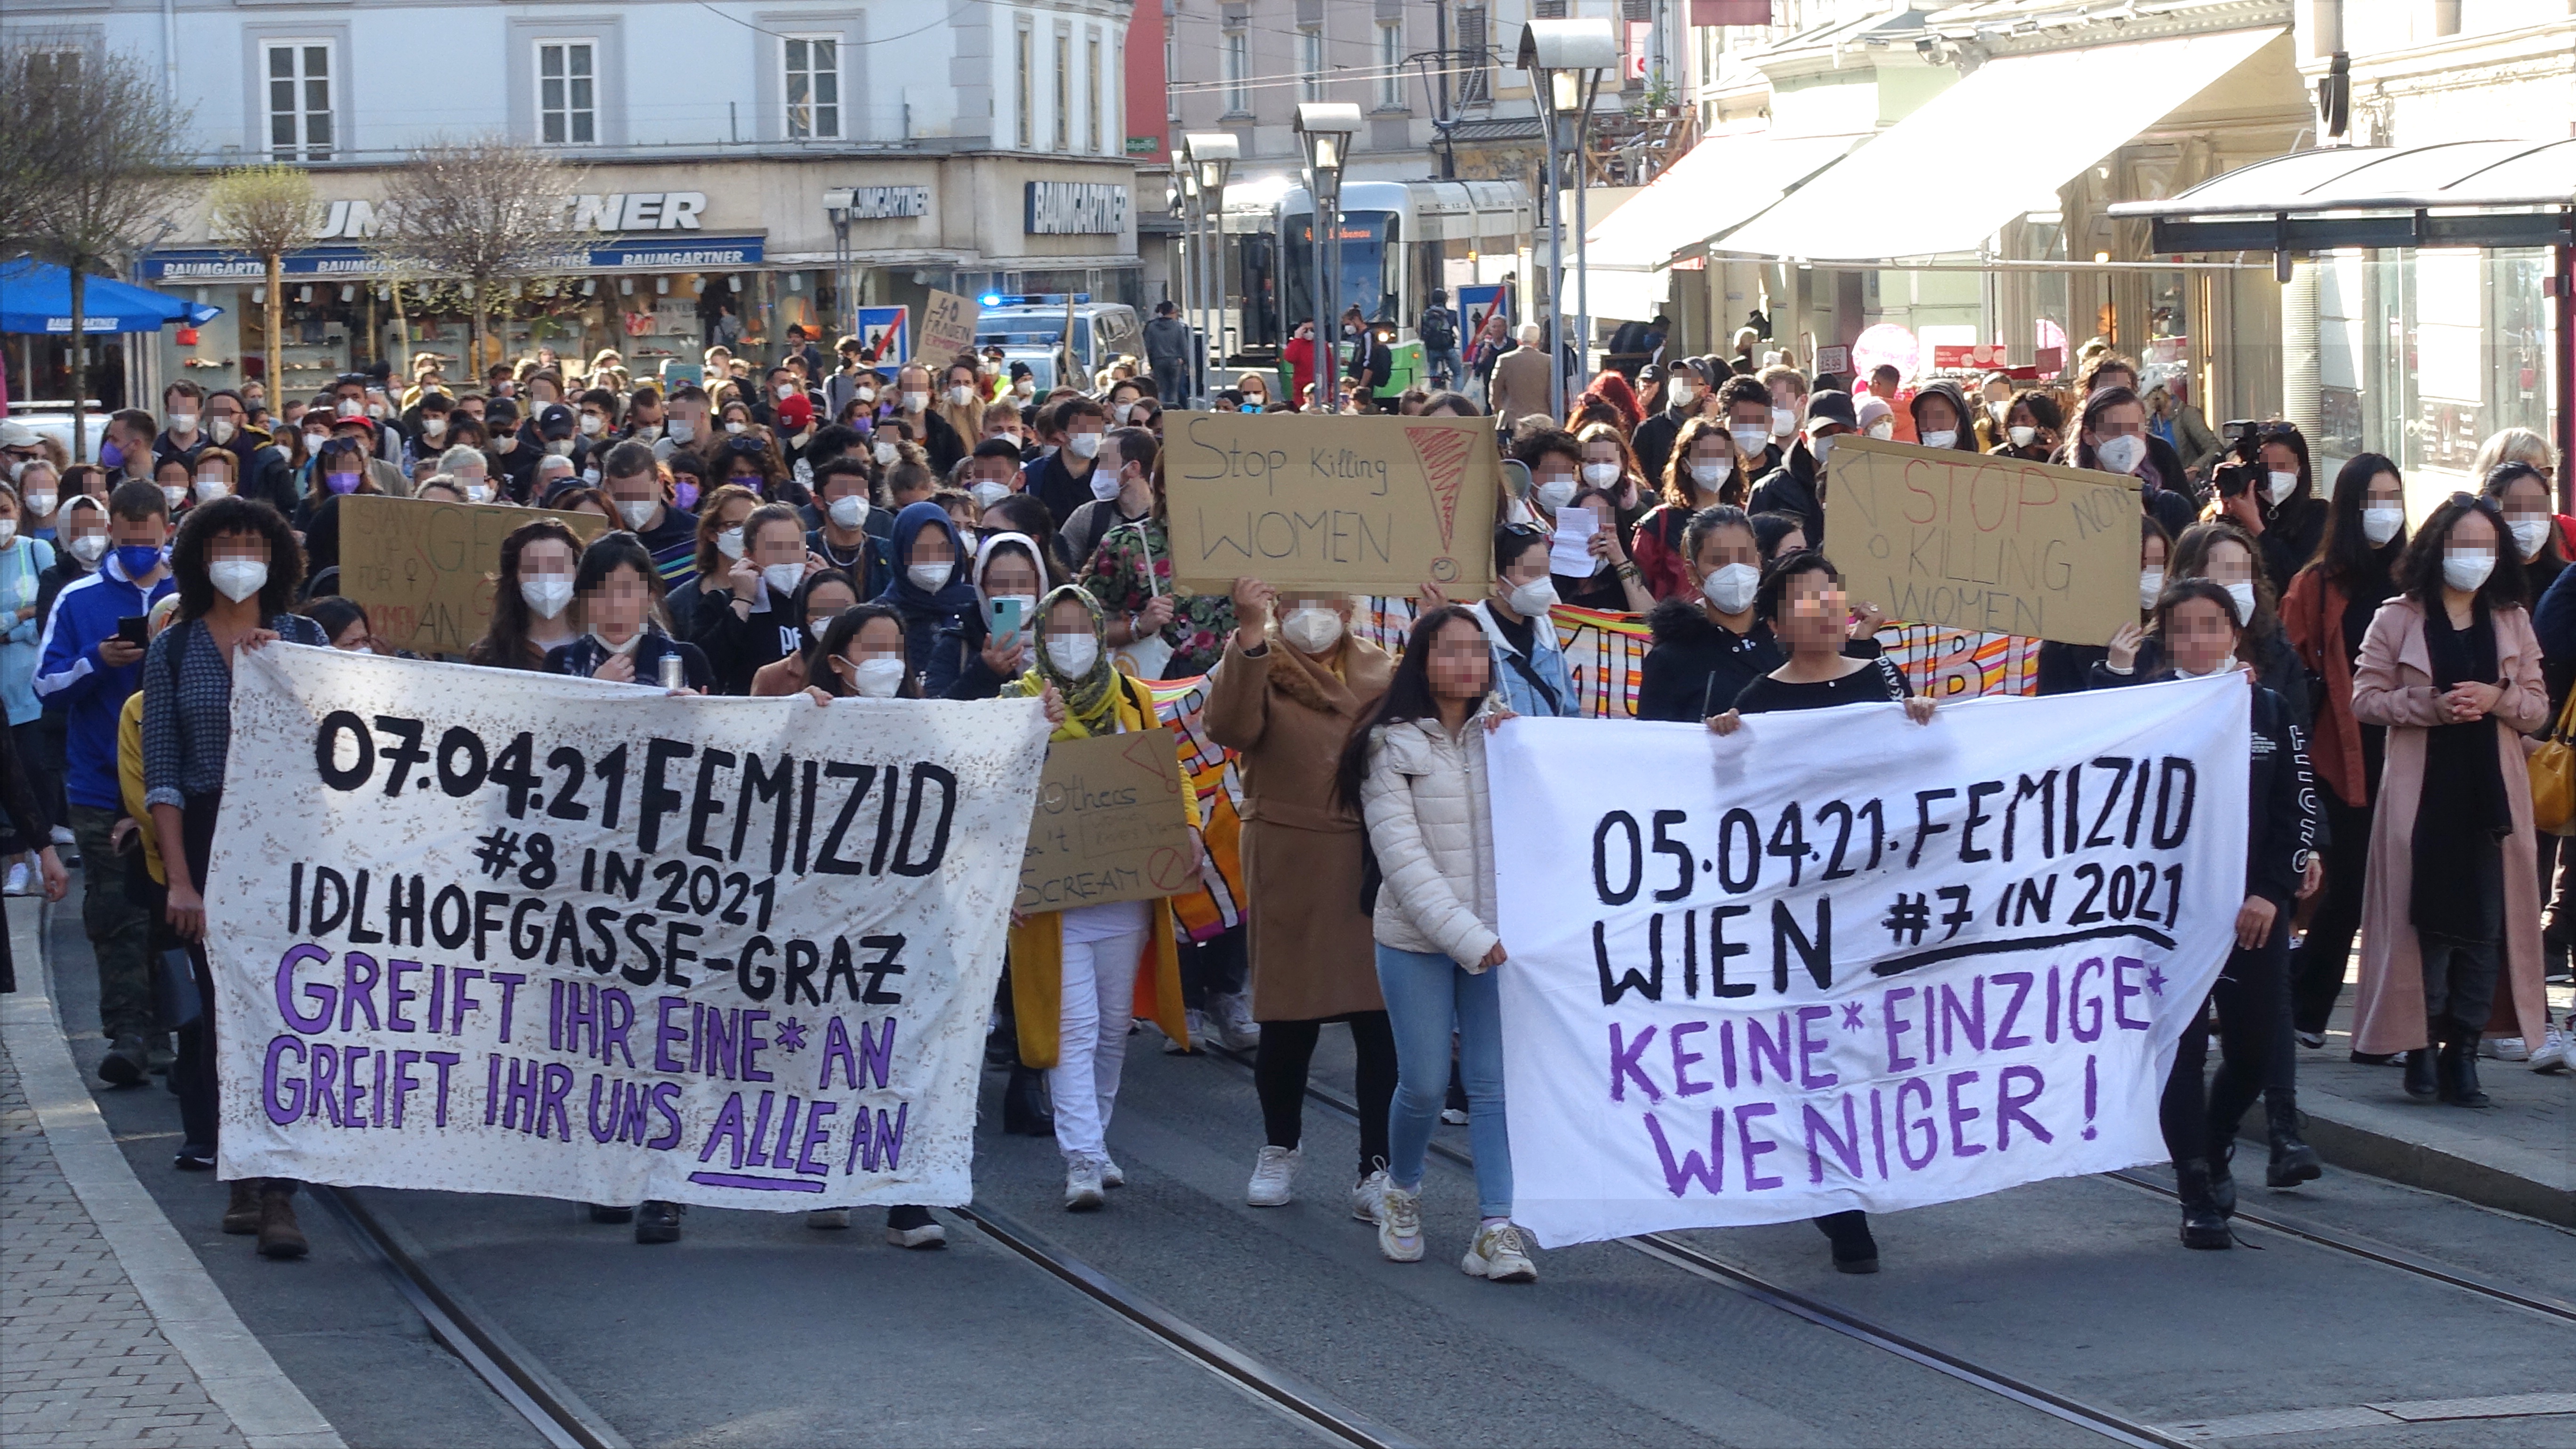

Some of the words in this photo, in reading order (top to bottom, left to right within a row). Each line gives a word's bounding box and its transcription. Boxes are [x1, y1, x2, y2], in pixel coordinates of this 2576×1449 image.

[621, 250, 744, 266] BAUMGARTNER
[1184, 417, 1287, 496] Stop
[1311, 447, 1388, 496] Killing
[1903, 459, 2058, 533] STOP
[2071, 479, 2132, 540] NOW
[1199, 507, 1392, 564] WOMEN
[1908, 525, 2071, 600] KILLING
[1888, 576, 2043, 634] WOMEN
[316, 710, 628, 829] 07.04.21
[637, 737, 957, 877] FEMIZID
[1907, 755, 2196, 869] FEMIZID
[473, 827, 557, 890] #8
[580, 848, 644, 902] IN
[653, 859, 776, 933] 2021
[1016, 867, 1141, 907] SCREAM
[288, 862, 907, 1006] IDLHOFGASSE-GRAZ
[1593, 893, 1832, 1006] WIEN
[1882, 883, 1973, 946] #7
[1996, 873, 2059, 927] IN
[2067, 861, 2183, 932] 2021
[274, 943, 526, 1044] GREIFT
[549, 978, 636, 1069] IHR
[819, 1015, 897, 1090] AN
[262, 1034, 460, 1128] GREIFT
[485, 1053, 574, 1143] IHR
[588, 1073, 682, 1151] UNS
[699, 1090, 837, 1176] ALLE
[847, 1102, 908, 1175] AN
